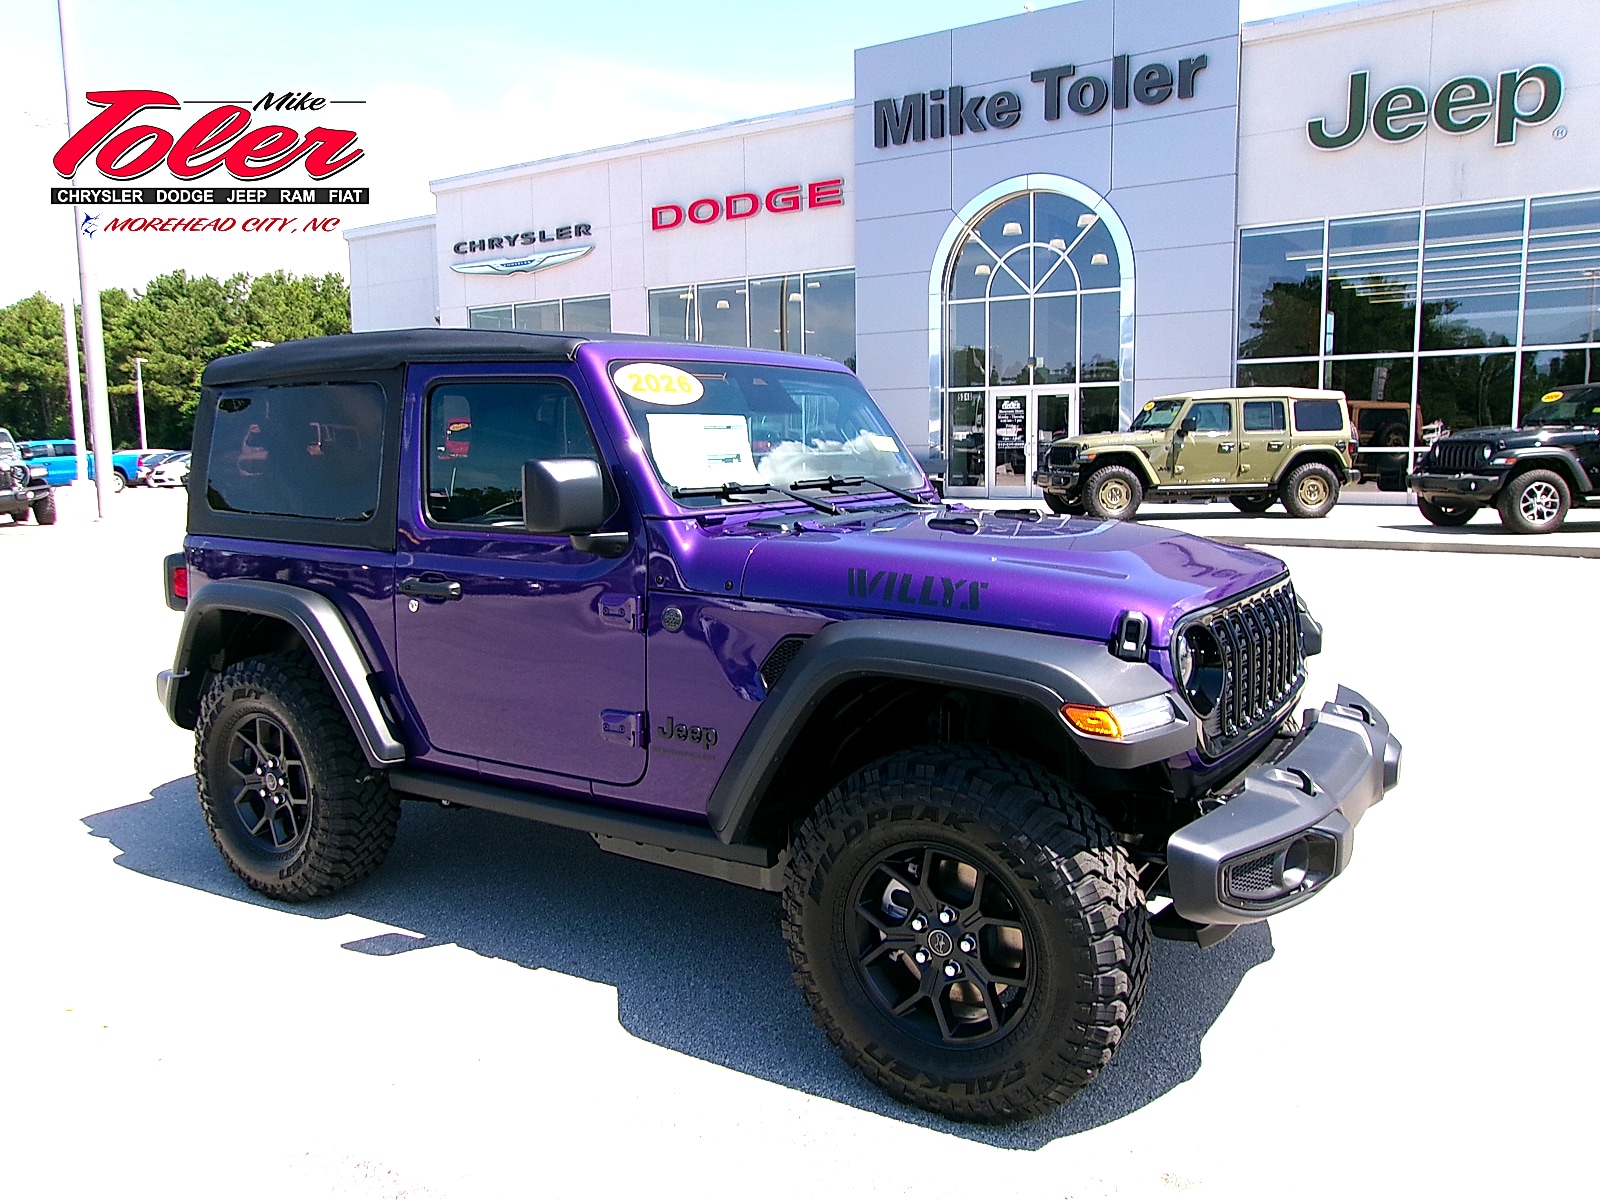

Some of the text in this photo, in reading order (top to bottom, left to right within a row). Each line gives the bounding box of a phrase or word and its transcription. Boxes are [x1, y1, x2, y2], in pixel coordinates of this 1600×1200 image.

[873, 53, 1208, 149] Mike Toler
[1305, 63, 1565, 152] Jeep
[651, 177, 845, 232] DODGE
[453, 222, 593, 255] CHRYSLER
[628, 373, 693, 394] 2026
[847, 567, 989, 611] WILLYS
[657, 716, 718, 750] Jeep
